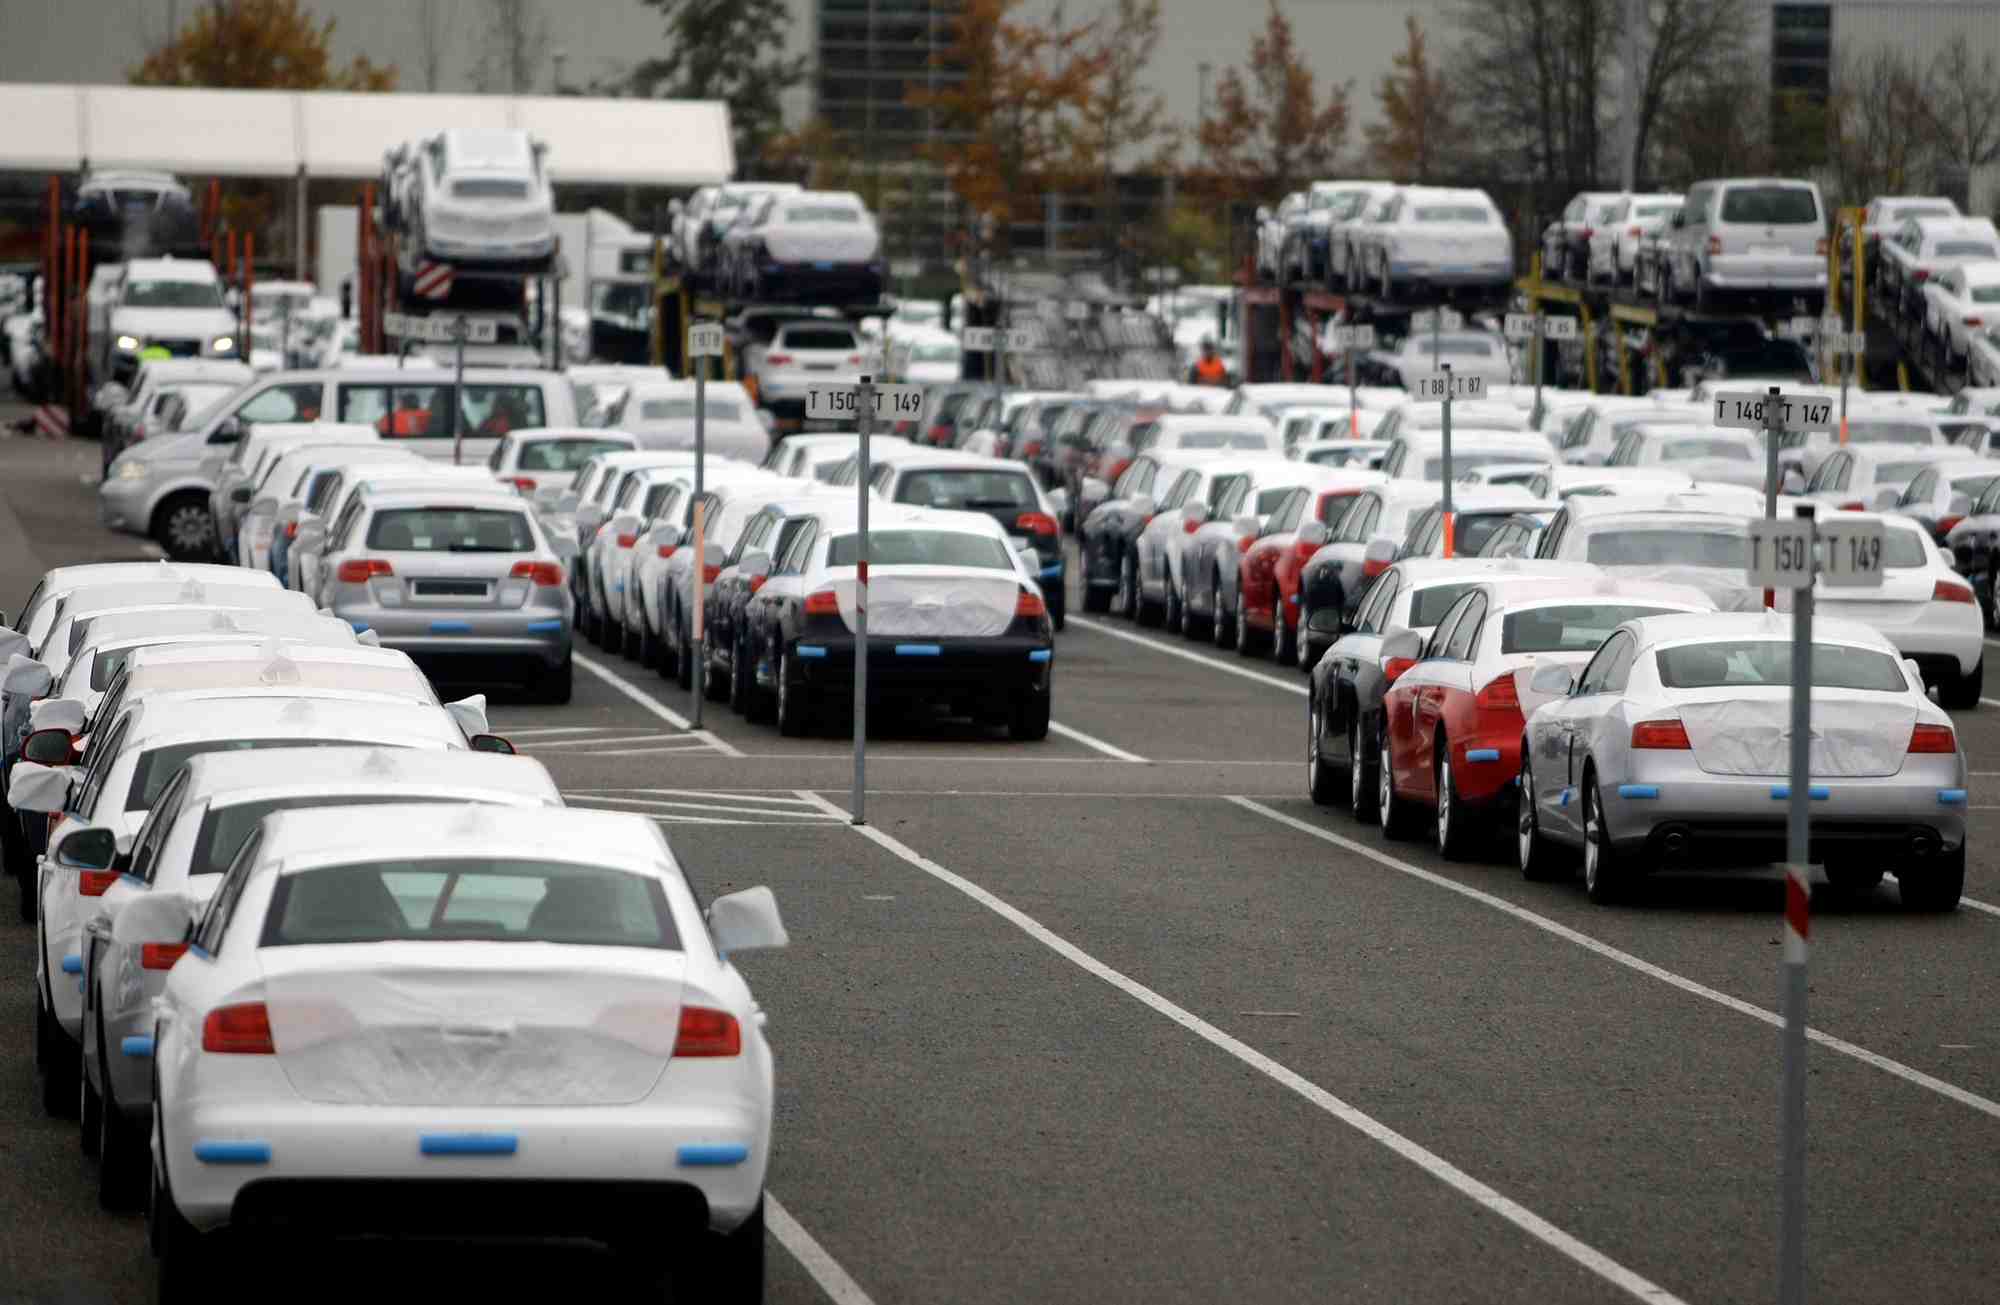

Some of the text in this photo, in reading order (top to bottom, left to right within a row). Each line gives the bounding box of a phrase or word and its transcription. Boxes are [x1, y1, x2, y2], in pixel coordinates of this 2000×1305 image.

[1420, 378, 1444, 395] T 88
[1457, 375, 1480, 393] T 87
[809, 390, 855, 410] T 150
[875, 392, 921, 412] T 149
[1717, 400, 1762, 421] T 148
[1783, 403, 1830, 424] T 147
[1751, 534, 1804, 571] T 150
[1828, 535, 1881, 573] T 149
